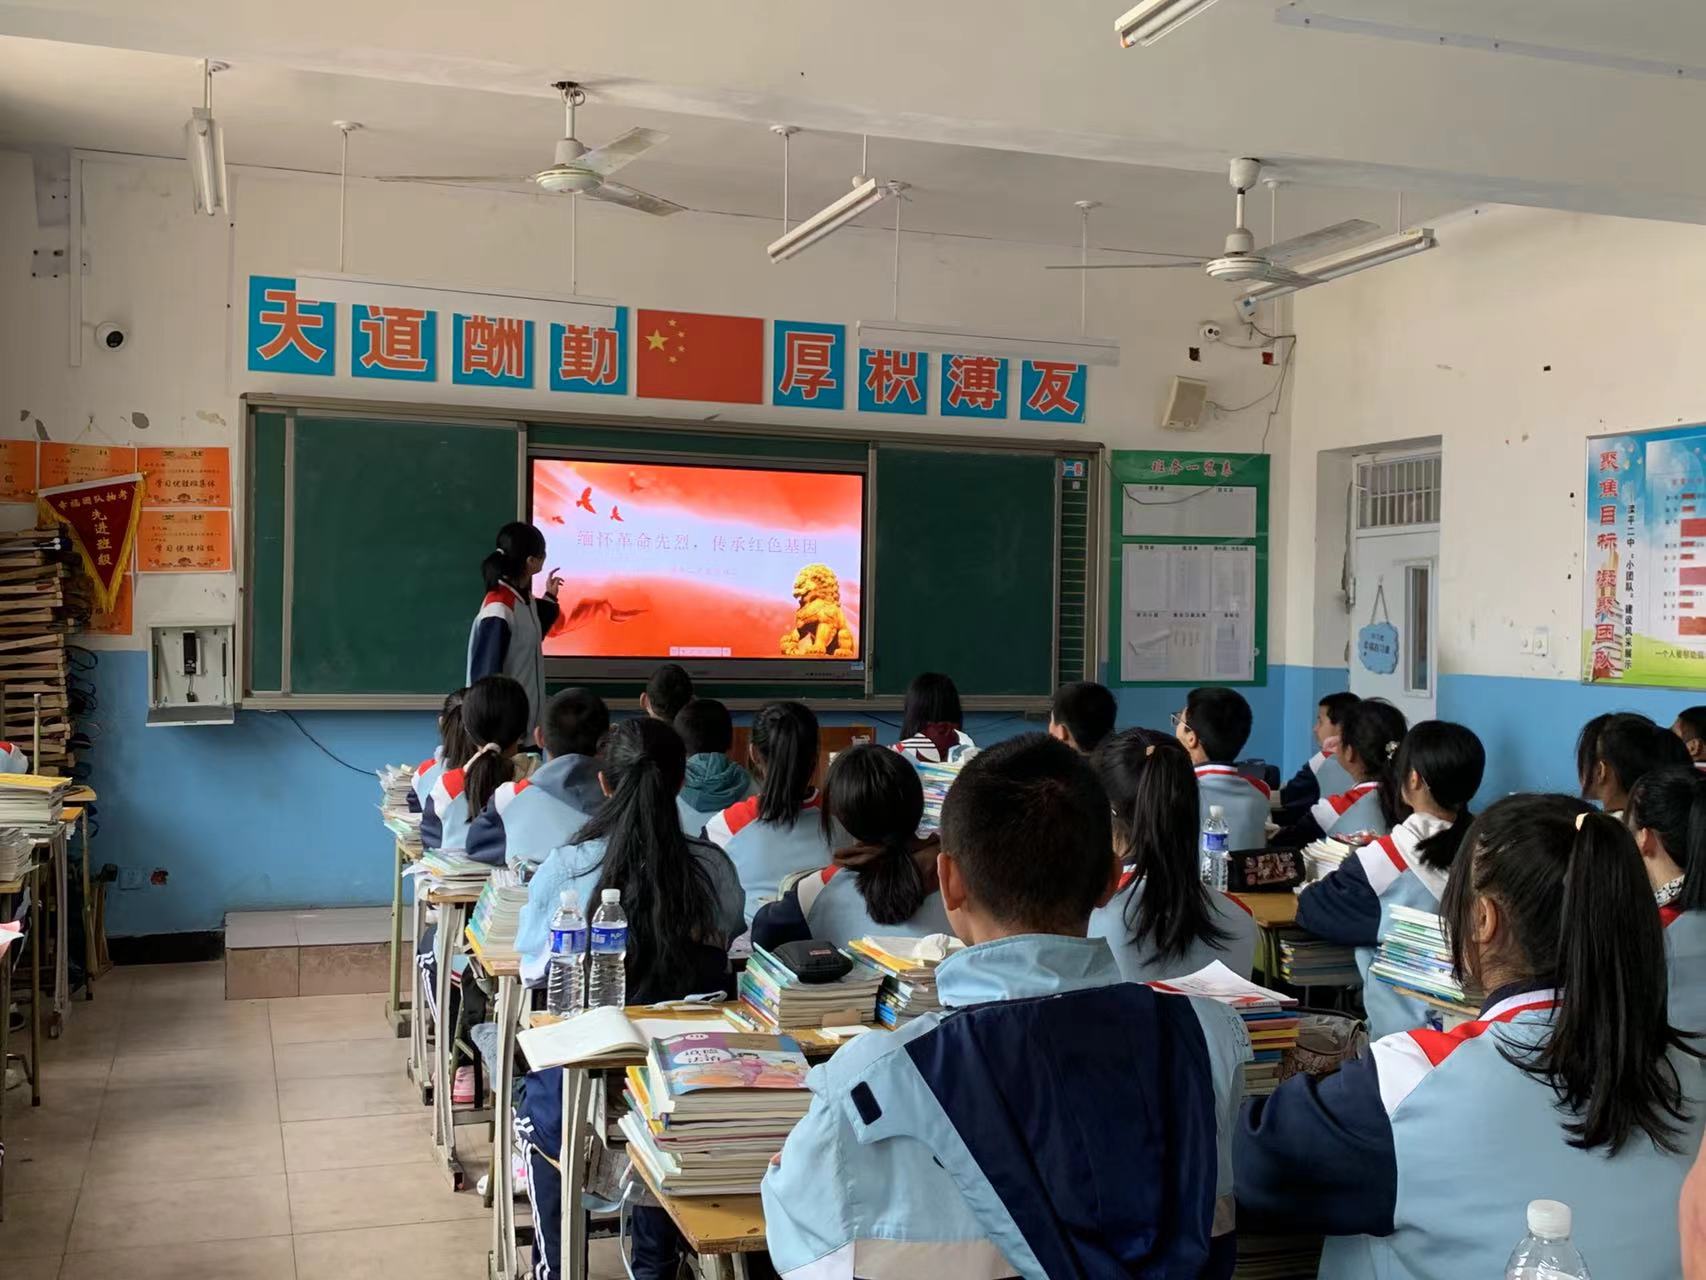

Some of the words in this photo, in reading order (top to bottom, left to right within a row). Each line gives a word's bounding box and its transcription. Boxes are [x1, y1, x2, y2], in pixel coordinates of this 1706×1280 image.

[257, 287, 620, 386] 天道酬勤
[91, 509, 112, 565] 先进班级
[1596, 450, 1620, 550] 聚焦目标
[1592, 568, 1617, 670] 凝聚团队
